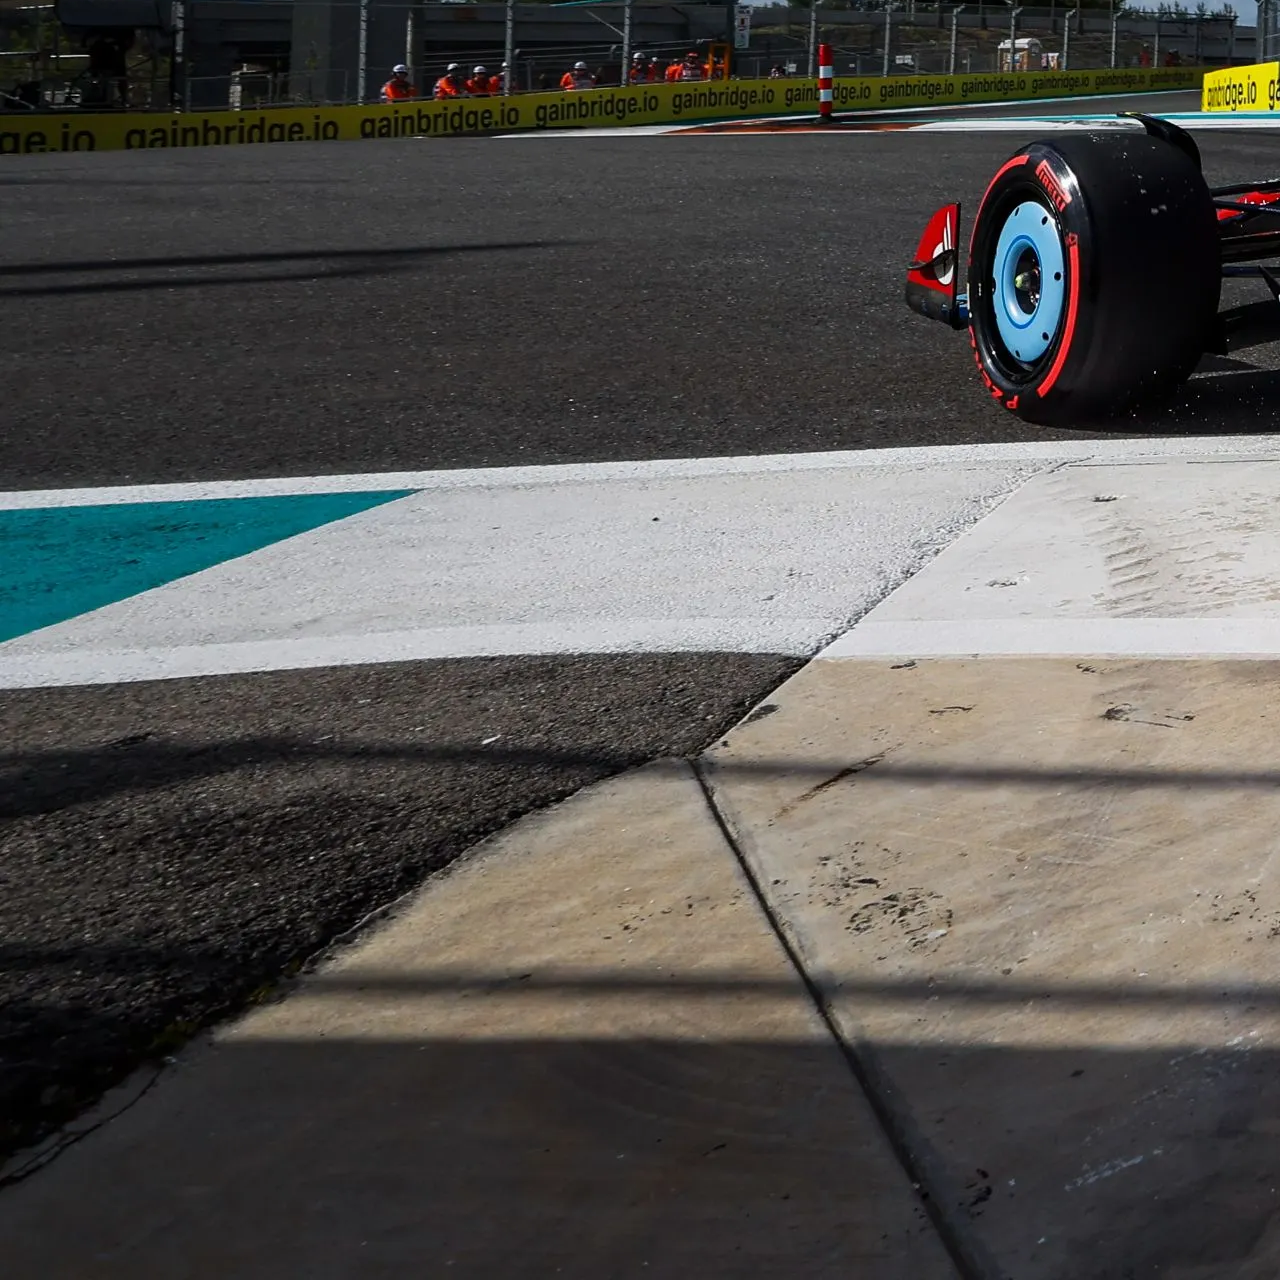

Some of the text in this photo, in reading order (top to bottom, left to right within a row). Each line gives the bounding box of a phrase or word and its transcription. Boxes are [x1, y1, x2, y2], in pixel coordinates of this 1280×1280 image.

[785, 82, 871, 107] gaindge.io
[880, 79, 954, 102] gainbridge.io
[961, 76, 1026, 97] gainbridge.io
[1032, 74, 1090, 94] gainbridge.io
[535, 90, 659, 127] gainbridge.io
[672, 85, 775, 114] gainbridge.io
[360, 103, 519, 138] gainbridge.io
